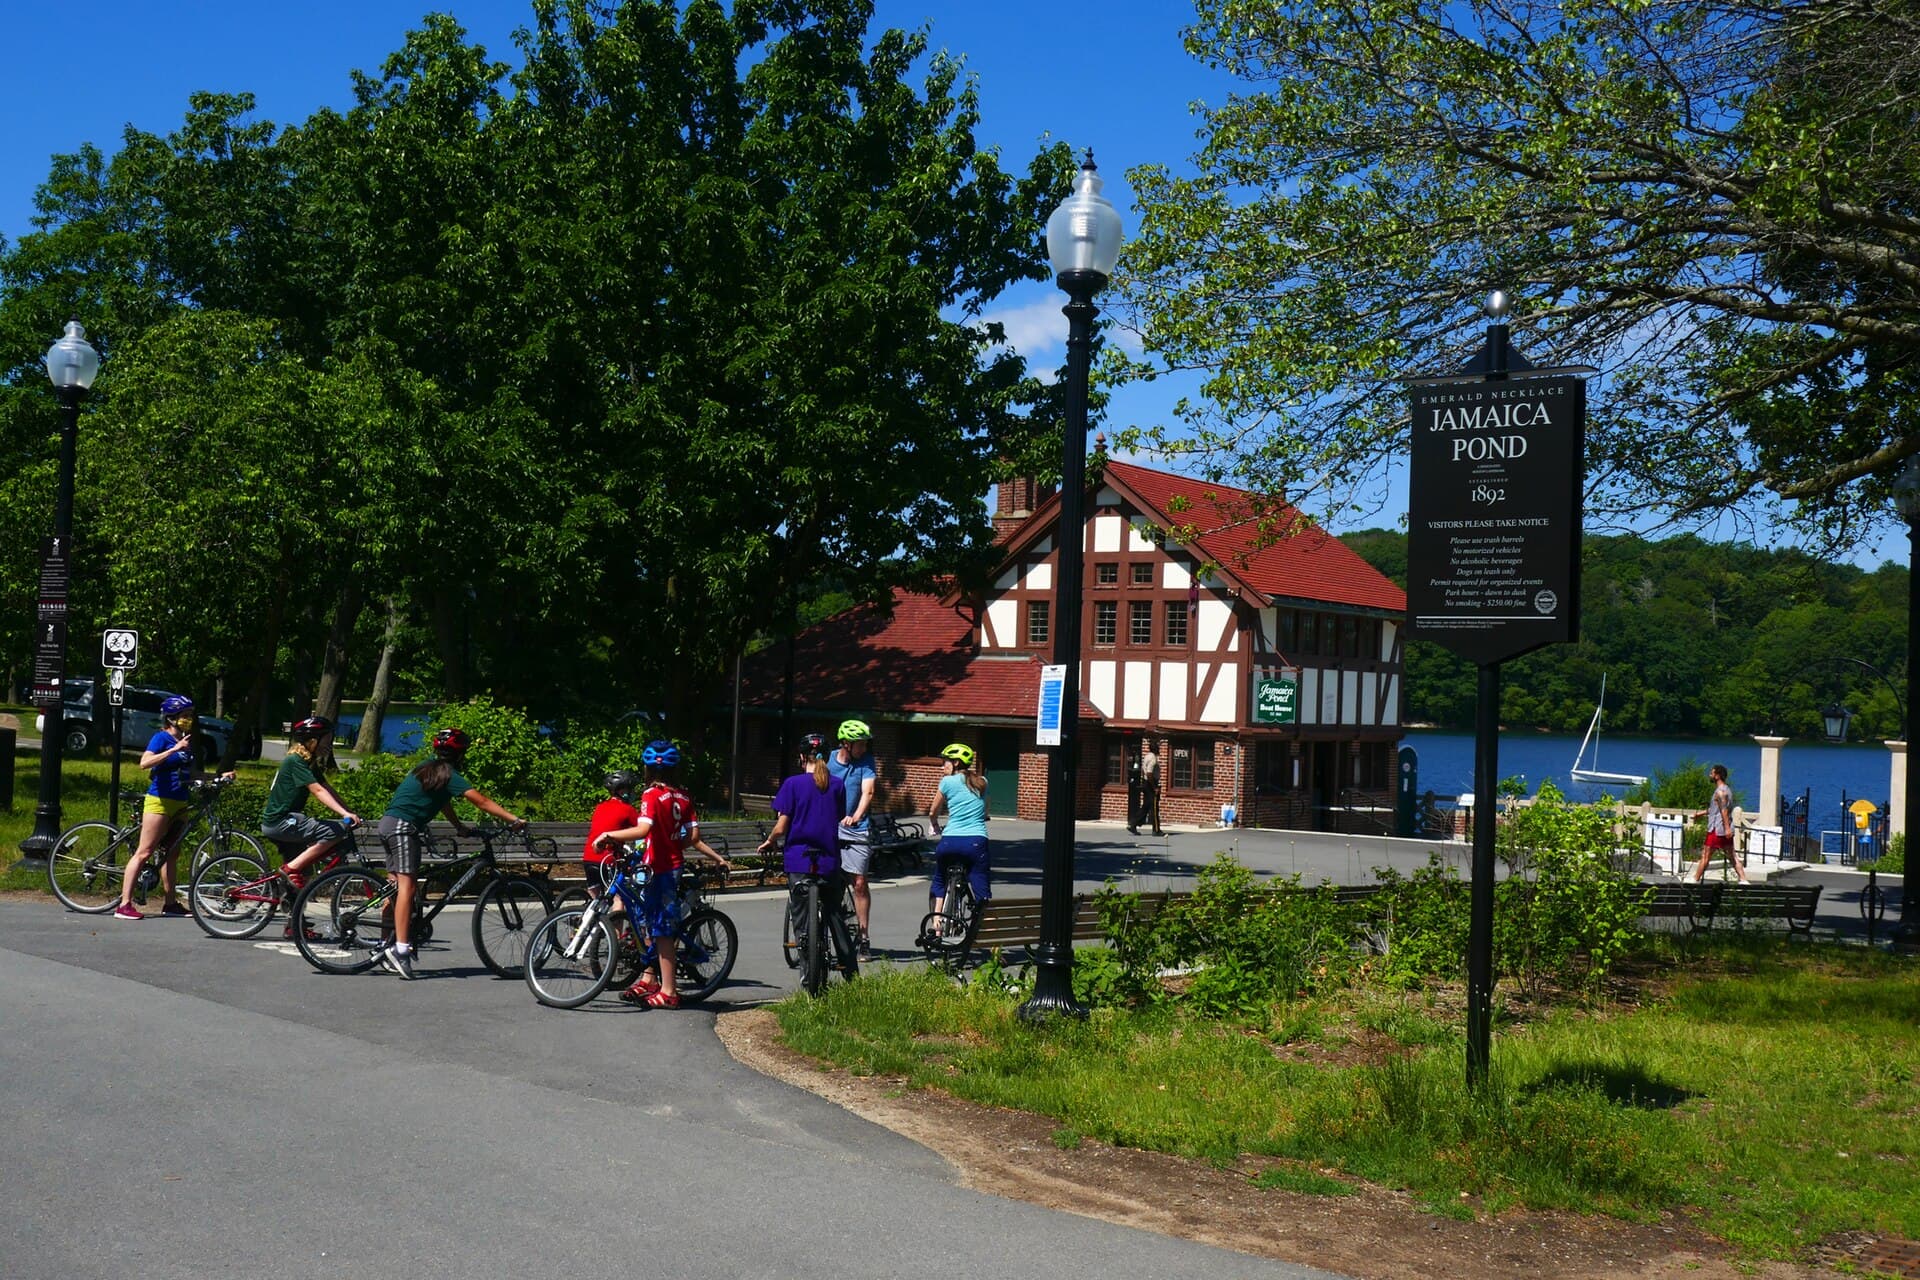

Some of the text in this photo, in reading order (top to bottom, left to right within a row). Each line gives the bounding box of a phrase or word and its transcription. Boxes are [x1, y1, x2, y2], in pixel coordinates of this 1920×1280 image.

[1421, 387, 1564, 404] EMERALD NECKLACE
[1429, 402, 1552, 432] JAMAICA
[1451, 435, 1527, 461] POND
[1471, 484, 1506, 506] 1892
[1428, 518, 1549, 529] VISITORS PLEASE TAKE NOTICE
[1450, 536, 1471, 545] Please
[1483, 536, 1501, 544] trash
[1501, 535, 1525, 543] barrels
[1452, 547, 1462, 555] No
[1460, 557, 1490, 565] alcoholic
[1491, 557, 1523, 566] beverages
[1456, 568, 1473, 577] Dogs
[1483, 567, 1501, 575] leash
[1501, 567, 1516, 576] only
[1451, 578, 1479, 586] required
[1479, 578, 1489, 587] for
[1489, 578, 1522, 586] organized
[1445, 589, 1461, 597] Park
[1484, 588, 1503, 596] dawn
[1511, 588, 1527, 596] dusk
[1445, 599, 1455, 607] No
[1455, 599, 1482, 608] smoking
[1487, 599, 1513, 607] $250.00
[1512, 599, 1527, 608] fine
[1259, 684, 1294, 699] Jamaica
[1265, 694, 1289, 702] Pond
[1174, 749, 1188, 757] OPEN
